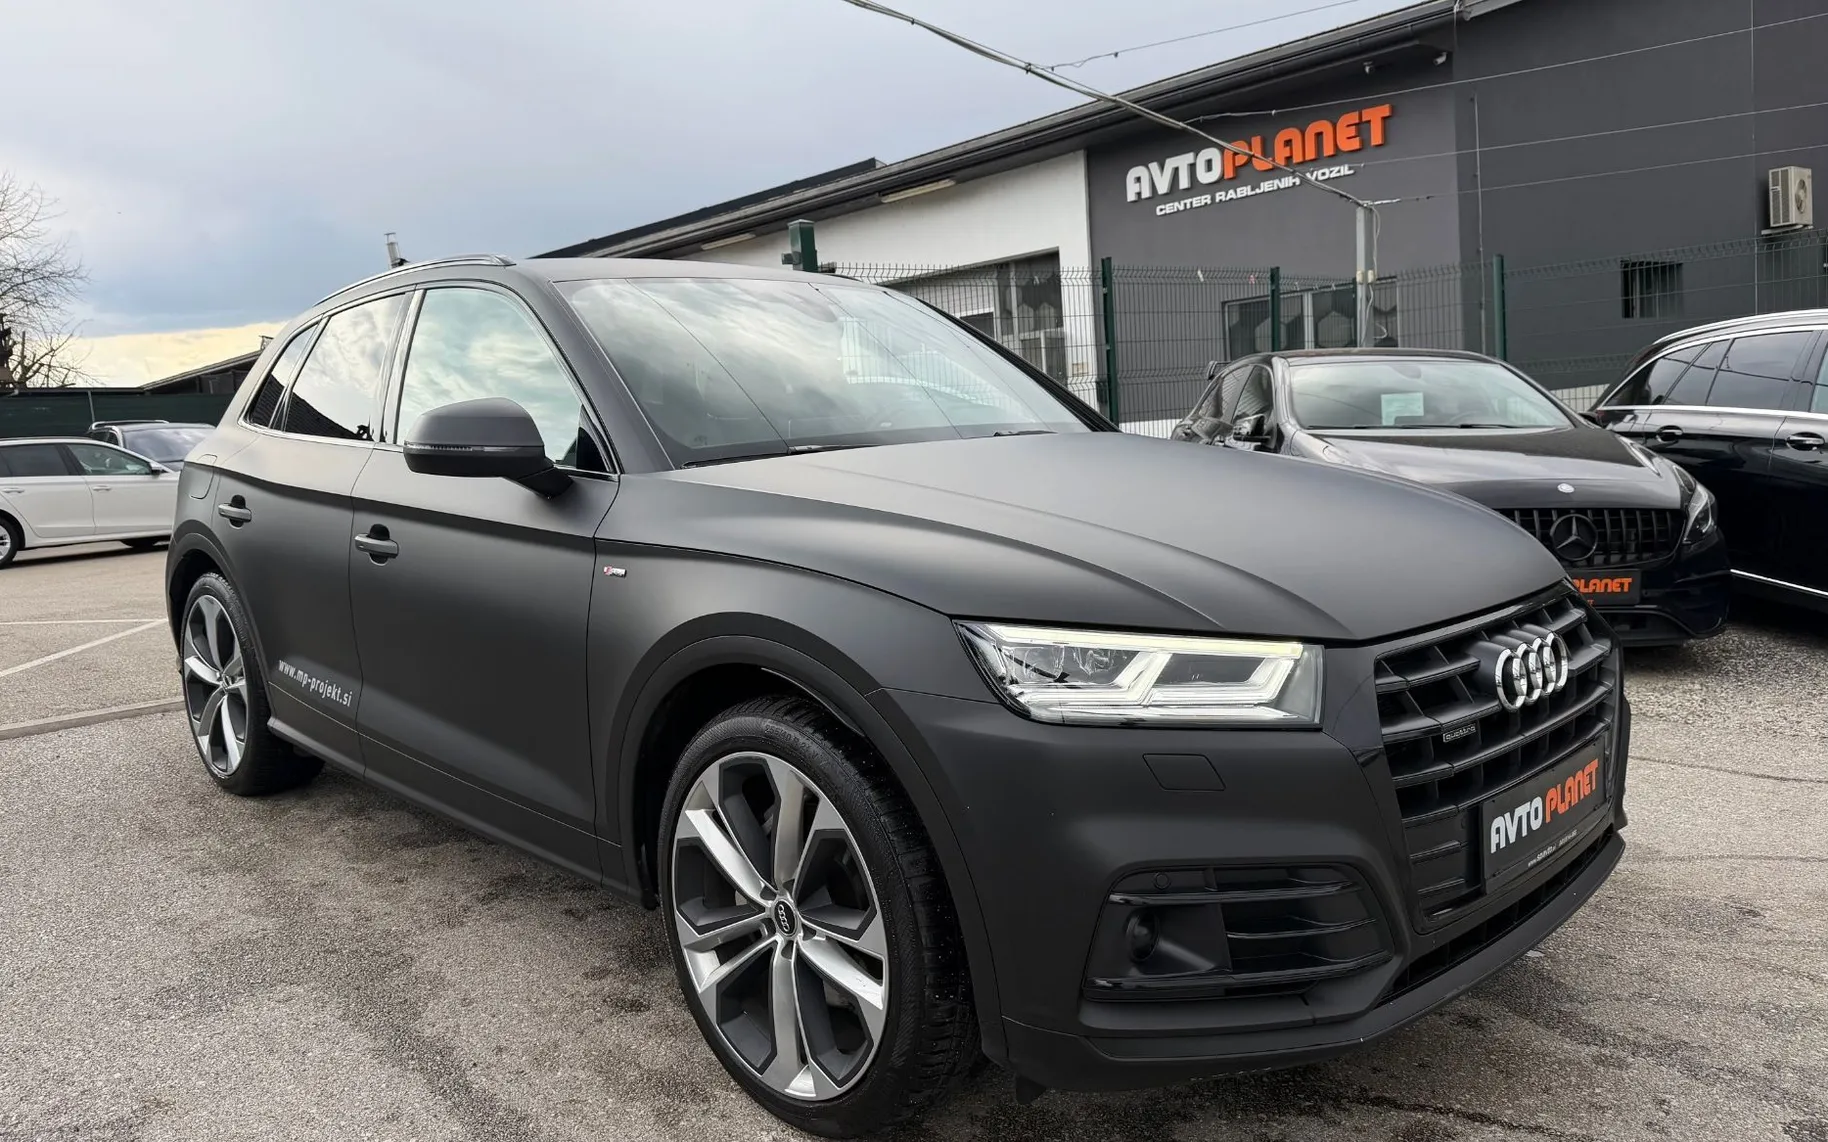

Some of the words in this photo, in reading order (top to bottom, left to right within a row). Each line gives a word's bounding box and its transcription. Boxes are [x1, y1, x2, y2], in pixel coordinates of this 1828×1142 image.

[1156, 194, 1212, 216] CENTER
[1215, 176, 1300, 203] RABLJENIH
[1306, 164, 1355, 181] VOZIL
[278, 660, 353, 707] www.mp-projekt.si
[1445, 725, 1476, 740] quattro
